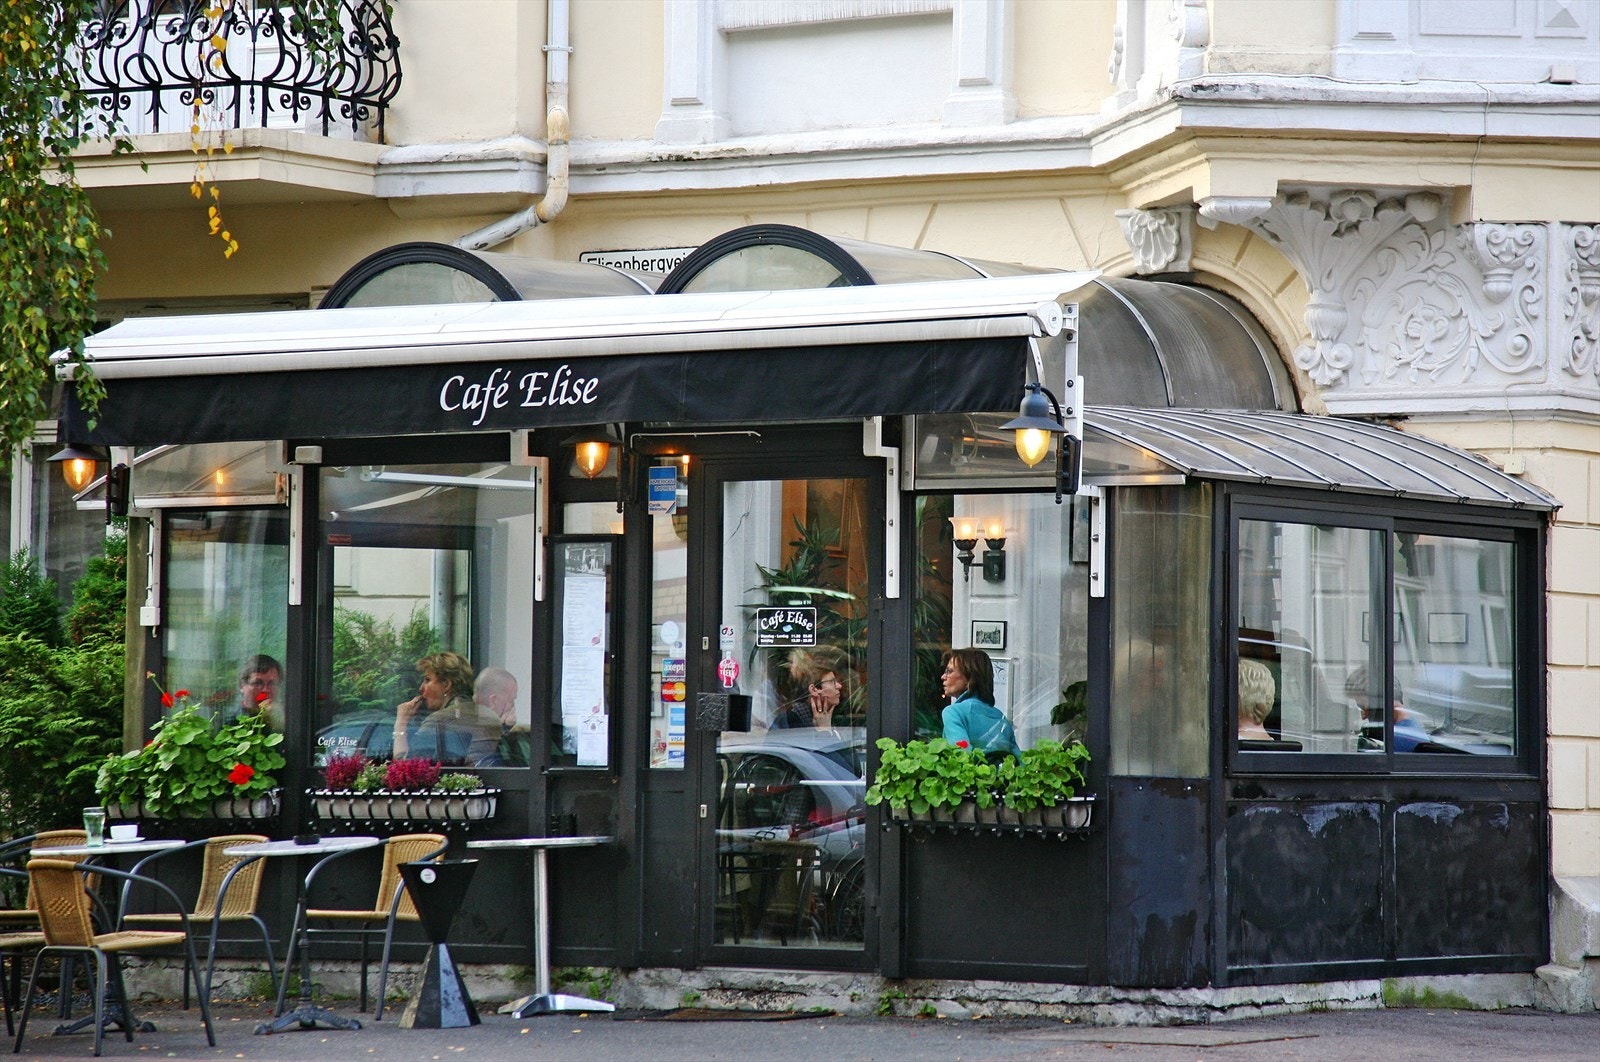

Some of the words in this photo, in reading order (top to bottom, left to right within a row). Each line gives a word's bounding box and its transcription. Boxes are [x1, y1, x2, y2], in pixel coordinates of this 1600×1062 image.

[587, 253, 686, 273] enbergve
[439, 368, 511, 426] Café
[519, 364, 599, 407] Elise
[761, 610, 785, 629] Café
[786, 611, 813, 630] Elise
[318, 737, 336, 747] Café
[338, 737, 358, 746] Elise
